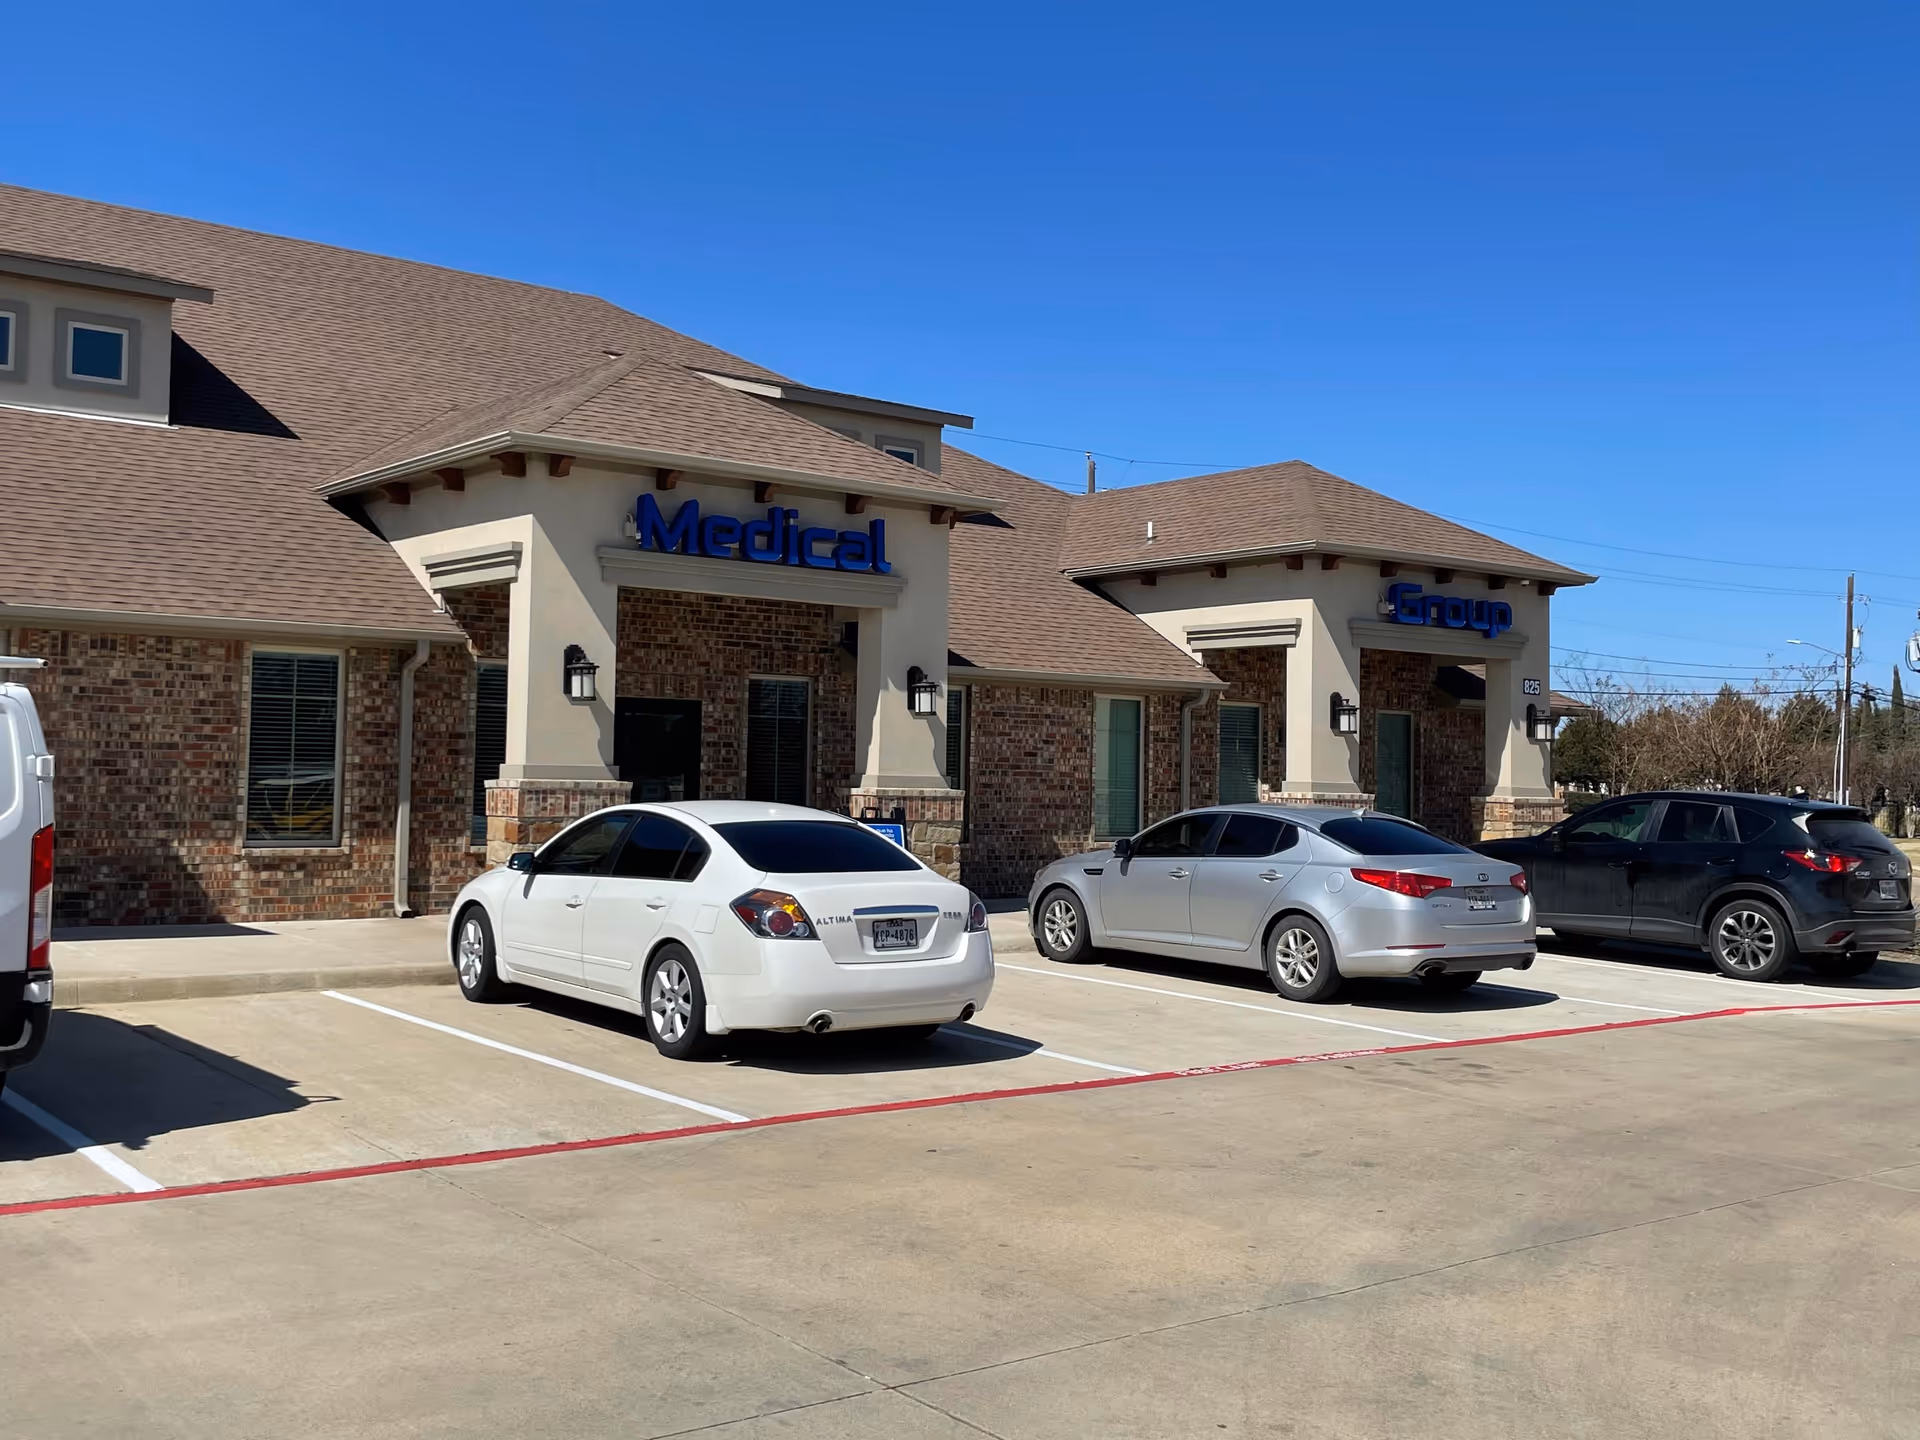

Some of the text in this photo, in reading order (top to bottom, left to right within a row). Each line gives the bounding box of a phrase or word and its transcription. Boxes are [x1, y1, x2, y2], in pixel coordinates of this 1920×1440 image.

[636, 493, 891, 573] Medical
[1388, 583, 1512, 639] Group
[1524, 680, 1540, 694] 825
[815, 915, 853, 926] ALTIMA
